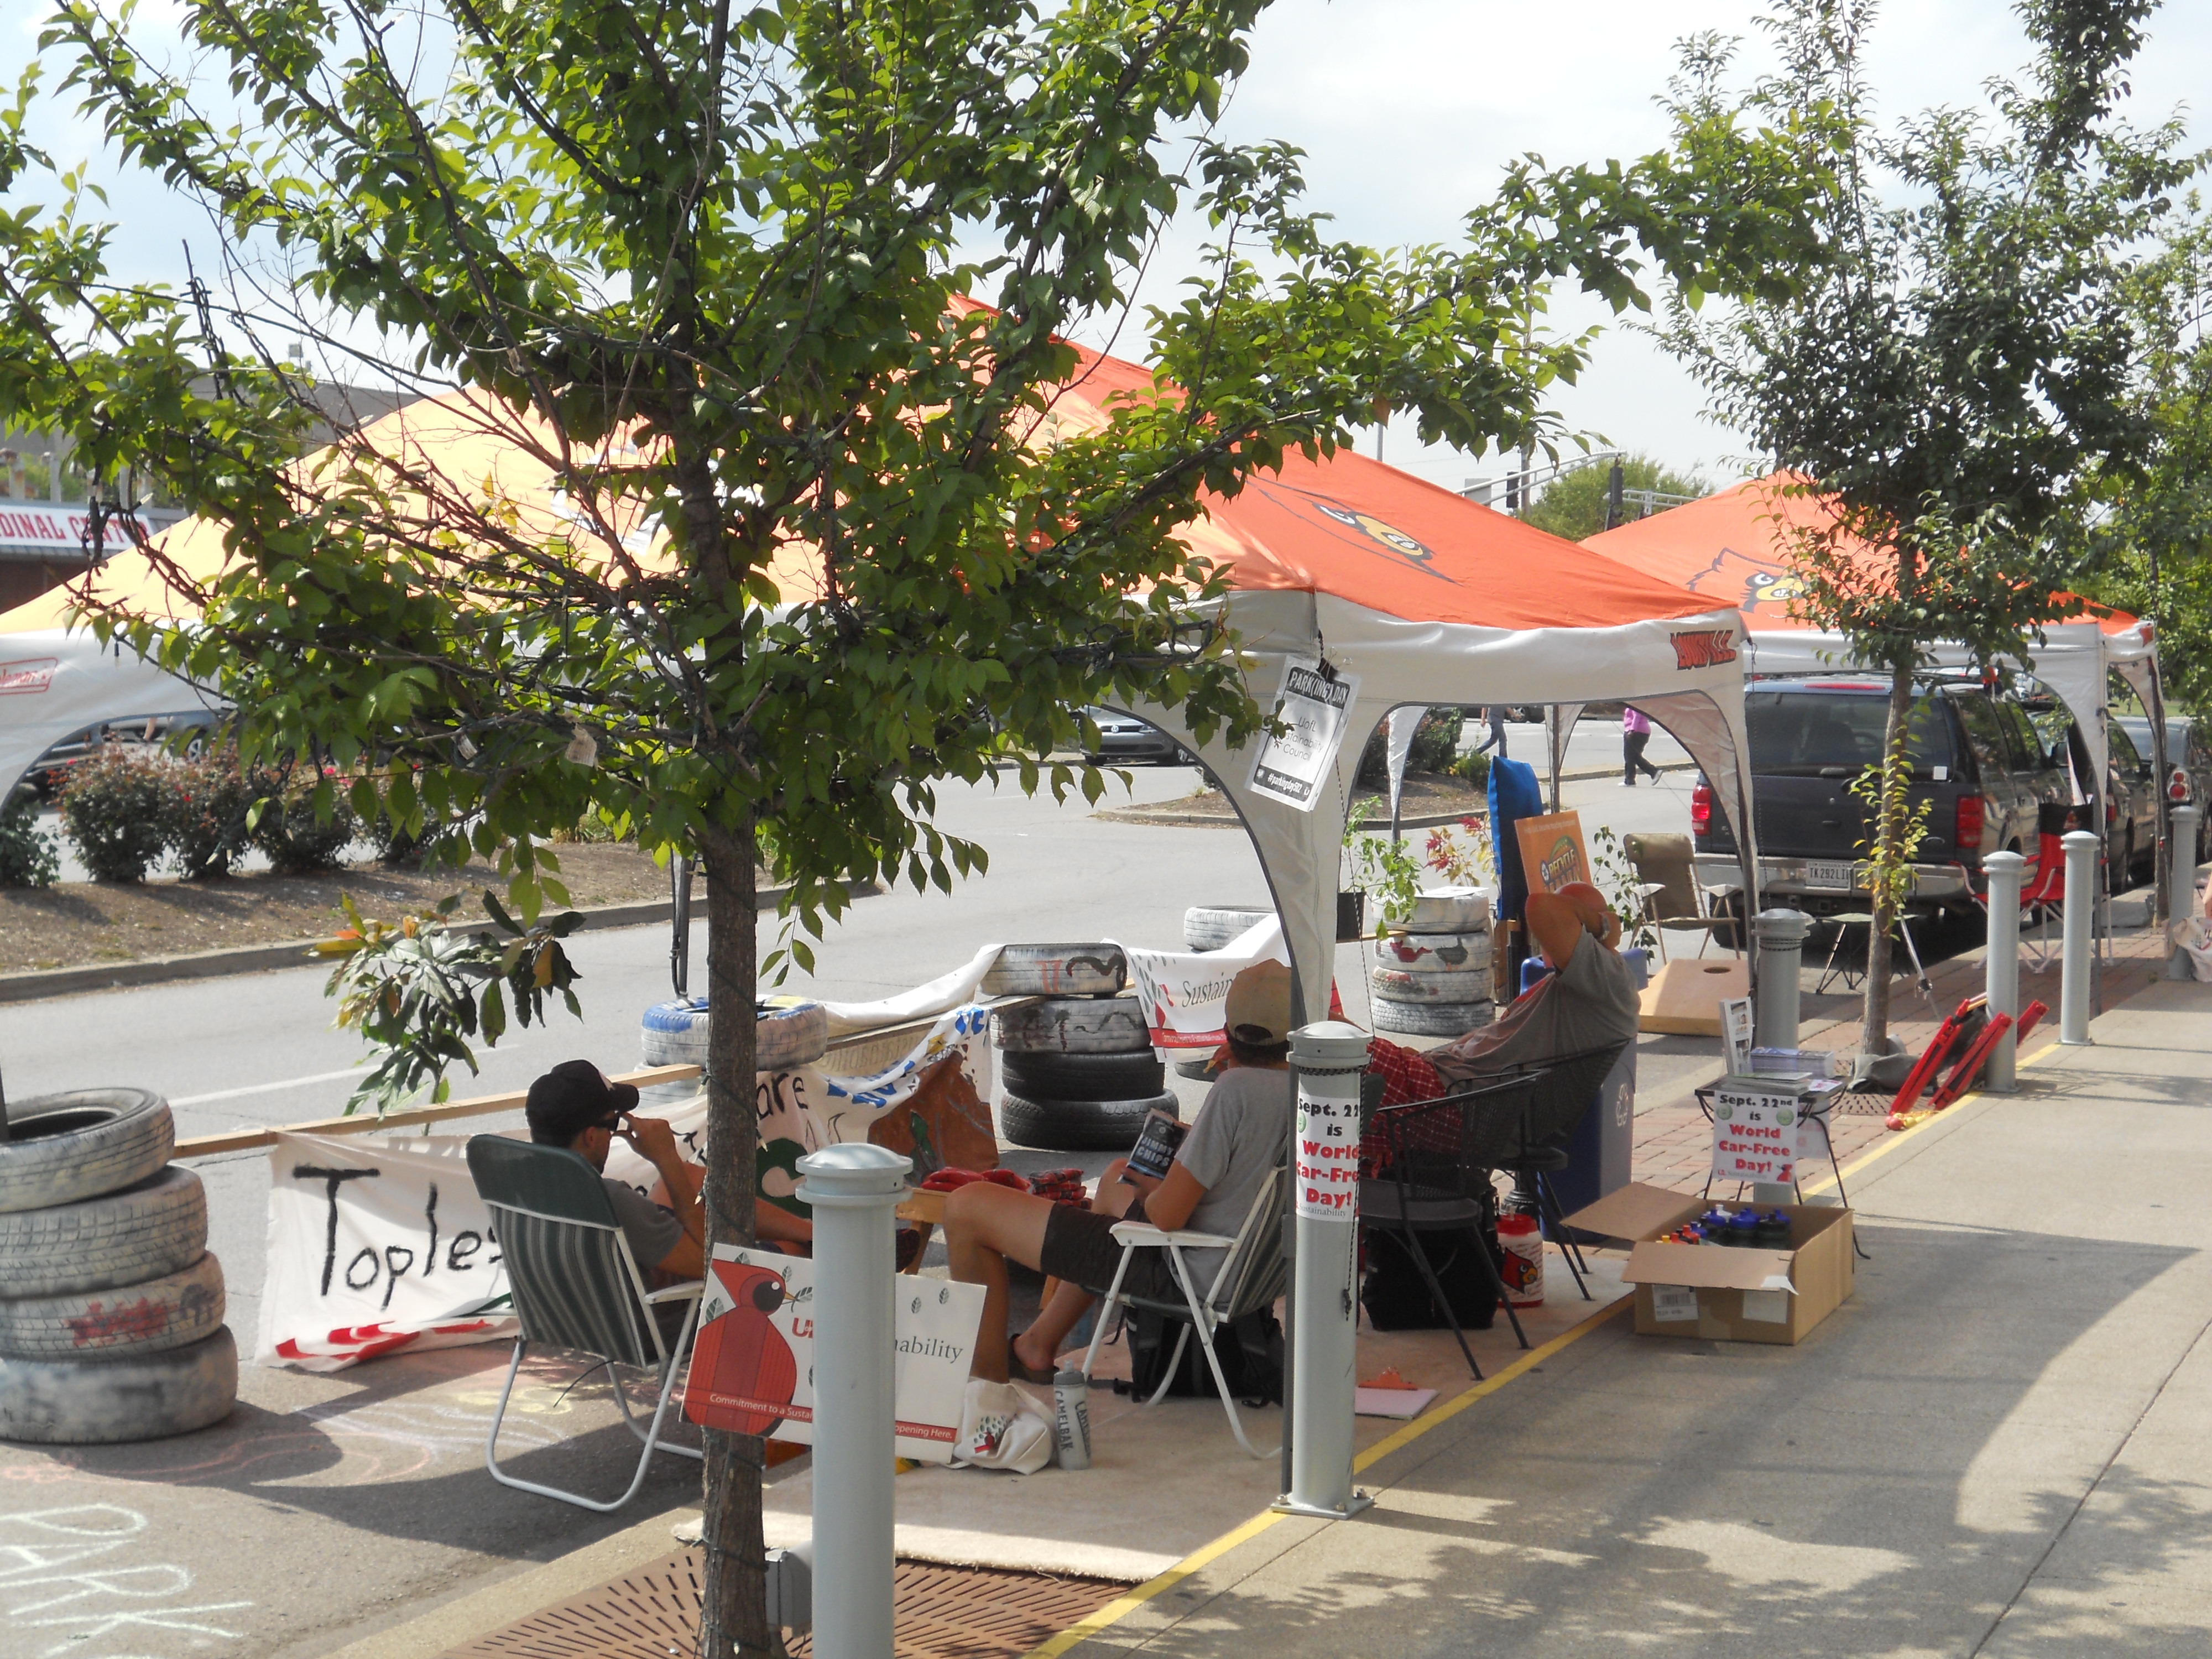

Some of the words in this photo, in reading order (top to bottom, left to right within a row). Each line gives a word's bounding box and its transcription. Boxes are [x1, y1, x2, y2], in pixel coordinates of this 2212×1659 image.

[0, 513, 66, 540] DINAL
[1286, 731, 1324, 753] stainability
[1284, 744, 1312, 761] Council
[1298, 1098, 1337, 1117] Sept.
[1720, 1094, 1756, 1106] Sept.
[1761, 1098, 1793, 1108] 22nd
[1750, 1112, 1761, 1121] is
[1327, 1123, 1343, 1136] is
[1729, 1124, 1781, 1139] World
[1136, 1146, 1170, 1166] CHIPS
[1140, 1137, 1173, 1156] JIMMY
[1302, 1139, 1359, 1160] World
[1719, 1140, 1790, 1156] Car-Free
[1297, 1161, 1358, 1182] ar-Fre
[1735, 1158, 1772, 1173] Day!
[1306, 1187, 1352, 1209] Day!
[710, 1394, 766, 1412] Commitment
[769, 1405, 778, 1413] to
[931, 1428, 952, 1439] Here.
[1055, 1390, 1073, 1451] CAMELBAK
